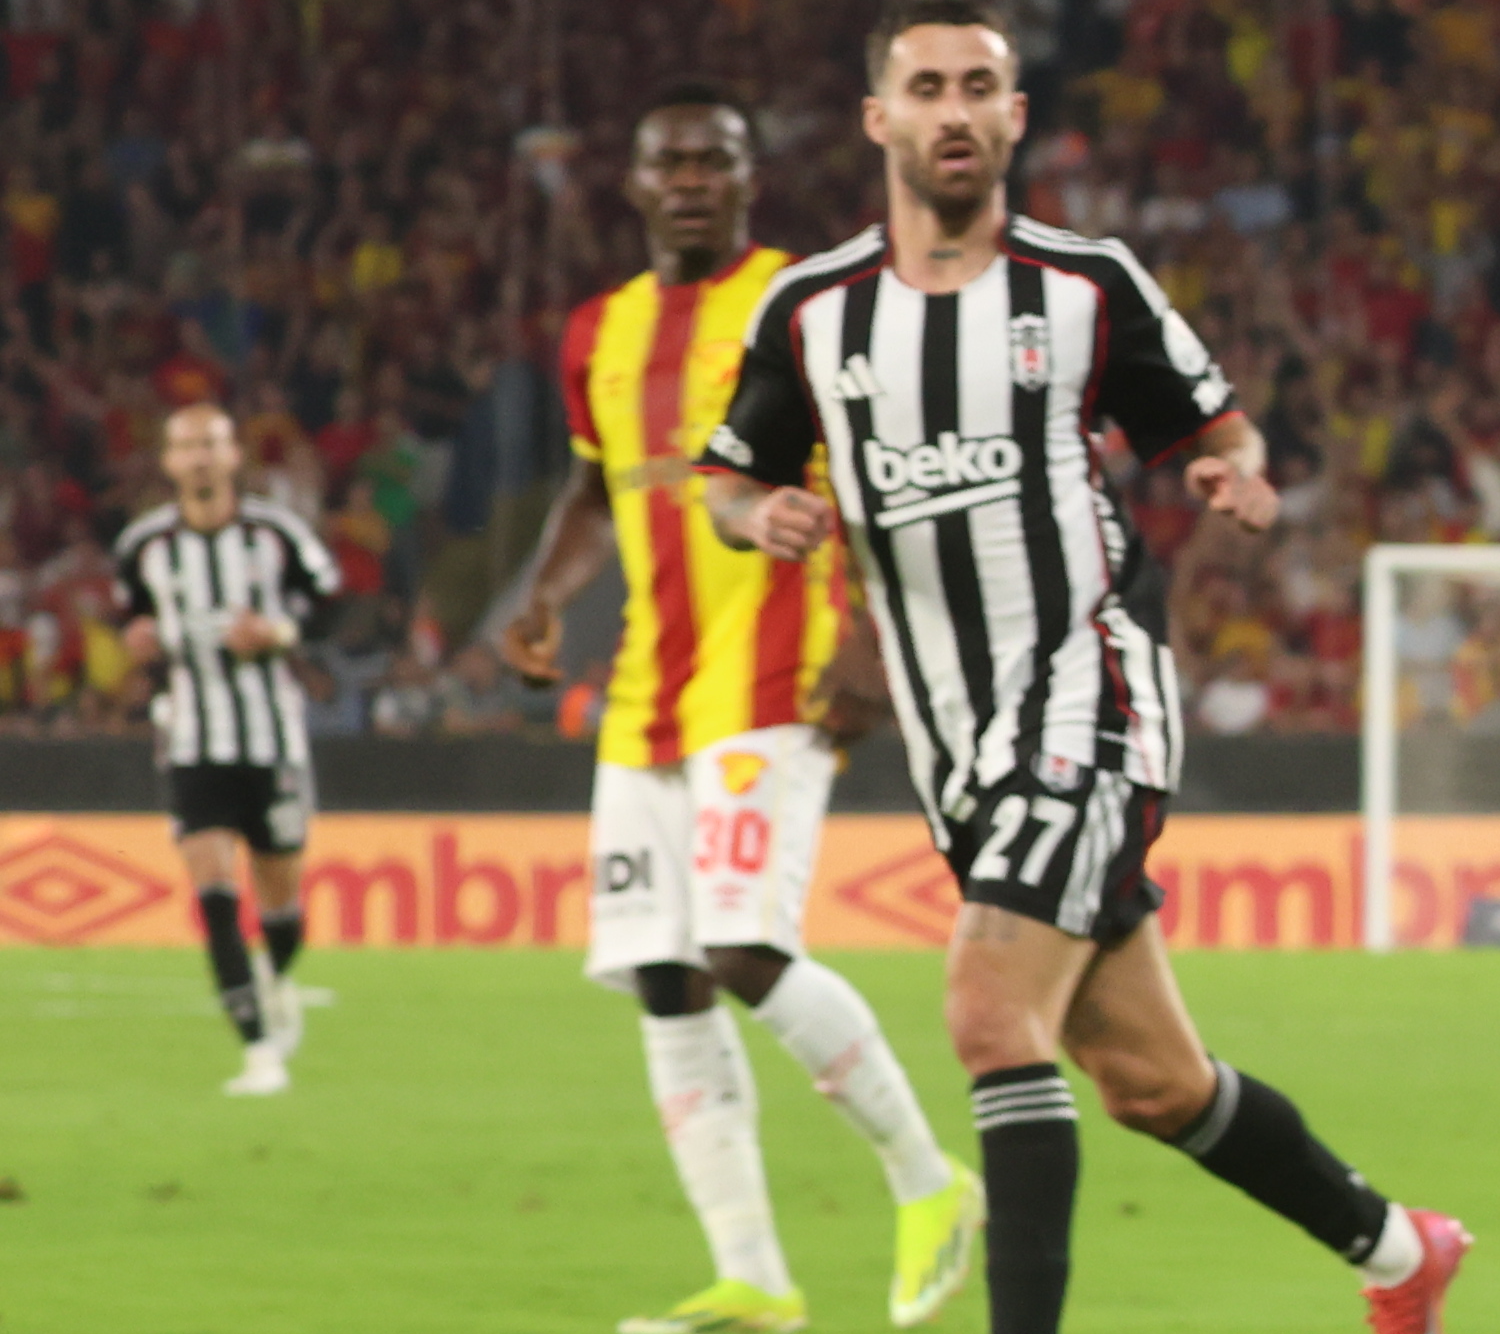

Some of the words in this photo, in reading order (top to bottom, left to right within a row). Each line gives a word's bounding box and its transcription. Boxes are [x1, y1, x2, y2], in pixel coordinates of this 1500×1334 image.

[864, 431, 1023, 493] beko
[693, 807, 772, 875] 30
[968, 793, 1077, 887] 27
